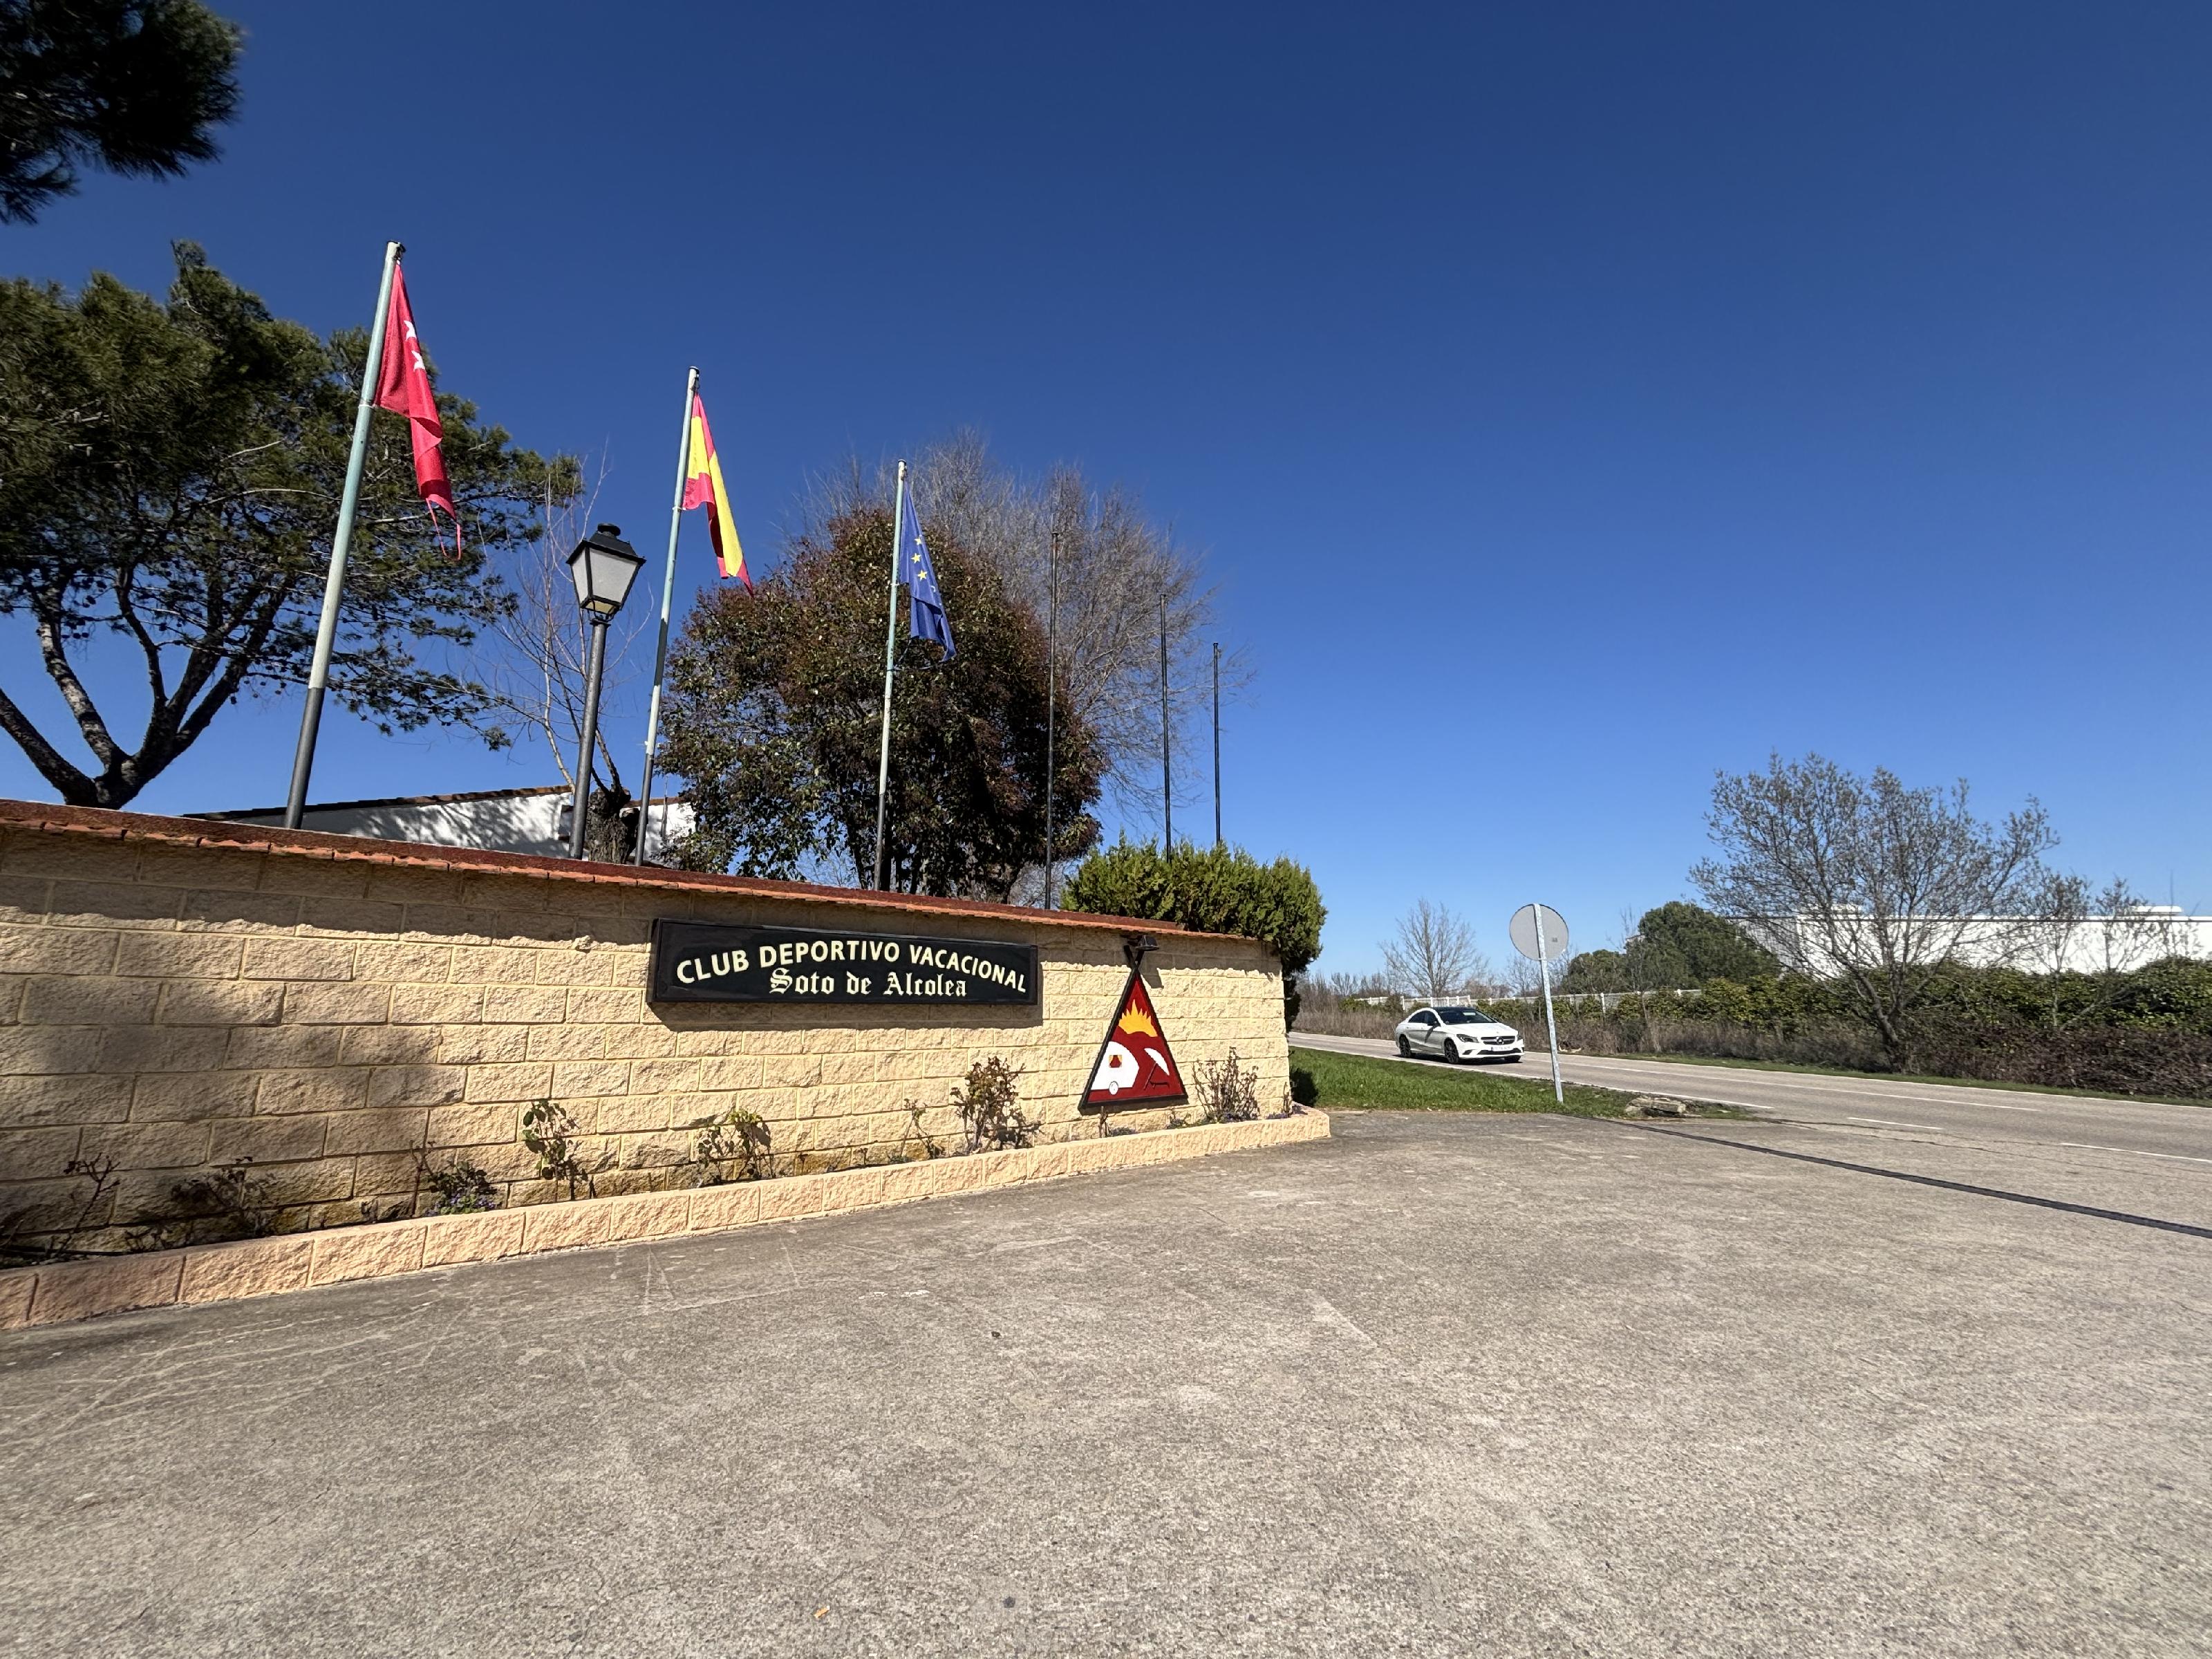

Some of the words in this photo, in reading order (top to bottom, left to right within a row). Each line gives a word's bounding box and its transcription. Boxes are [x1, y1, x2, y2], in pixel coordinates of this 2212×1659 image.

[677, 950, 749, 984] CLUB
[759, 940, 900, 968] DEPORTIVO
[909, 944, 1026, 993] VACACIONAL
[769, 967, 834, 995] Soto
[846, 971, 872, 995] de
[883, 971, 967, 997] Alcolea
